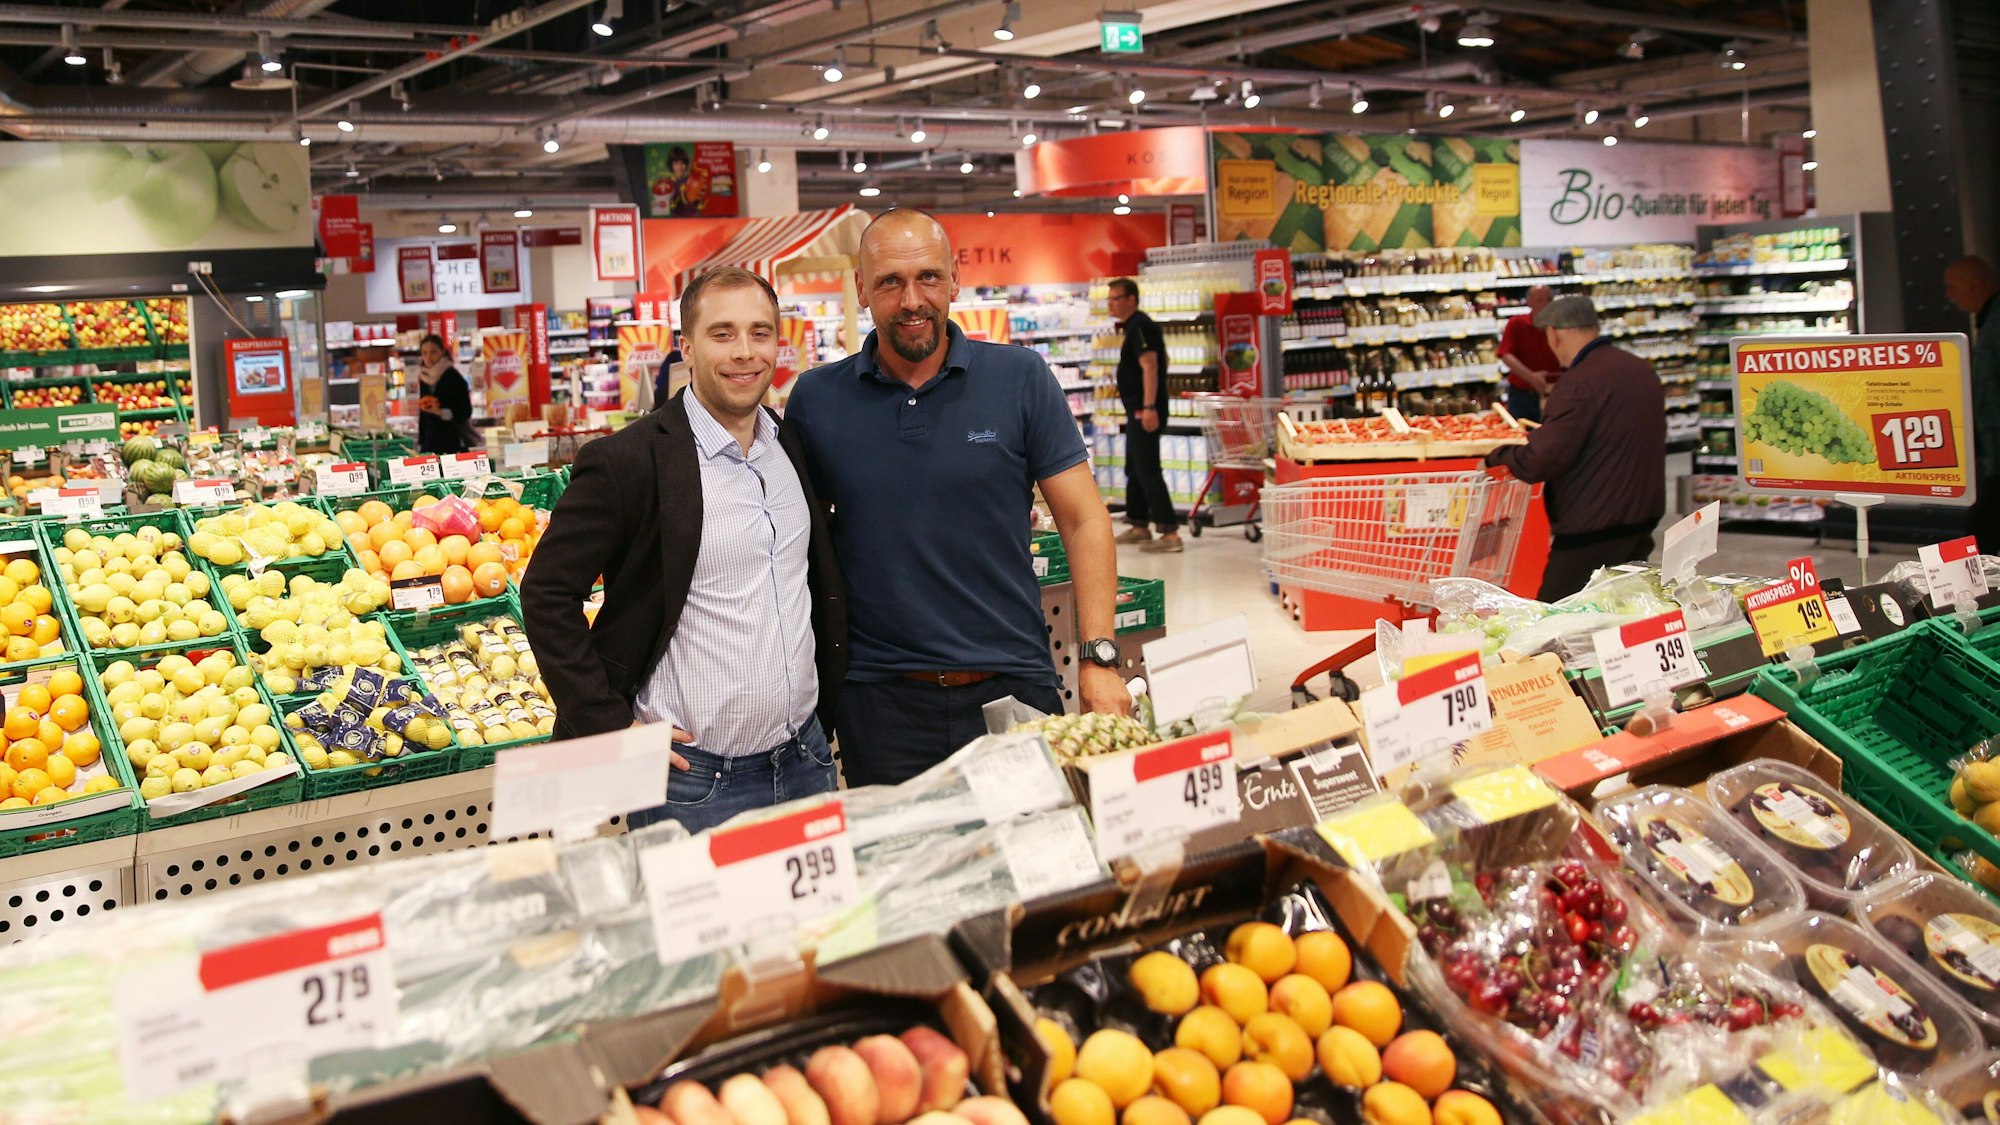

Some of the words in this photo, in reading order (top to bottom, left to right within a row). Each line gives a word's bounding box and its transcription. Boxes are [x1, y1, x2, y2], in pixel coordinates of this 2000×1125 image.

[1228, 185, 1269, 203] Region
[1295, 178, 1383, 209] Regionale
[1386, 178, 1460, 204] Produkte
[1480, 186, 1512, 202] Region
[1689, 193, 1708, 214] für
[1711, 193, 1747, 219] jeden
[1751, 195, 1772, 220] Tag
[599, 212, 632, 222] AKTION
[484, 234, 514, 243] AKTION
[402, 249, 429, 257] AKTION
[958, 248, 1012, 265] ETIK
[536, 311, 547, 364] DROGERIE
[1743, 344, 1910, 373] AKTIONSPREIS
[1915, 343, 1937, 364] %
[1881, 415, 1944, 464] 1.29
[420, 465, 435, 476] 2.49
[474, 460, 486, 471] 1.79
[349, 472, 364, 483] 0.99
[1895, 471, 1961, 482] AKTIONSPREIS
[214, 487, 230, 497] 0.99
[1931, 485, 1952, 493] REWE
[78, 497, 95, 508] 0.59
[427, 587, 441, 599] 1.79
[1747, 582, 1796, 609] AKTIONSPREIS
[1790, 562, 1816, 590] %
[1798, 599, 1822, 629] 1.49
[1664, 619, 1684, 632] REWE
[1655, 638, 1685, 672] 3.49
[1454, 663, 1479, 681] REWE
[1491, 674, 1555, 701] PINEAPPLES
[1442, 685, 1477, 727] 7.90
[1184, 764, 1223, 808] 4.99
[1313, 770, 1359, 791] Supersweet
[1244, 771, 1298, 811] Ernte
[786, 845, 837, 900] 2.99
[303, 964, 371, 1027] 2.79
